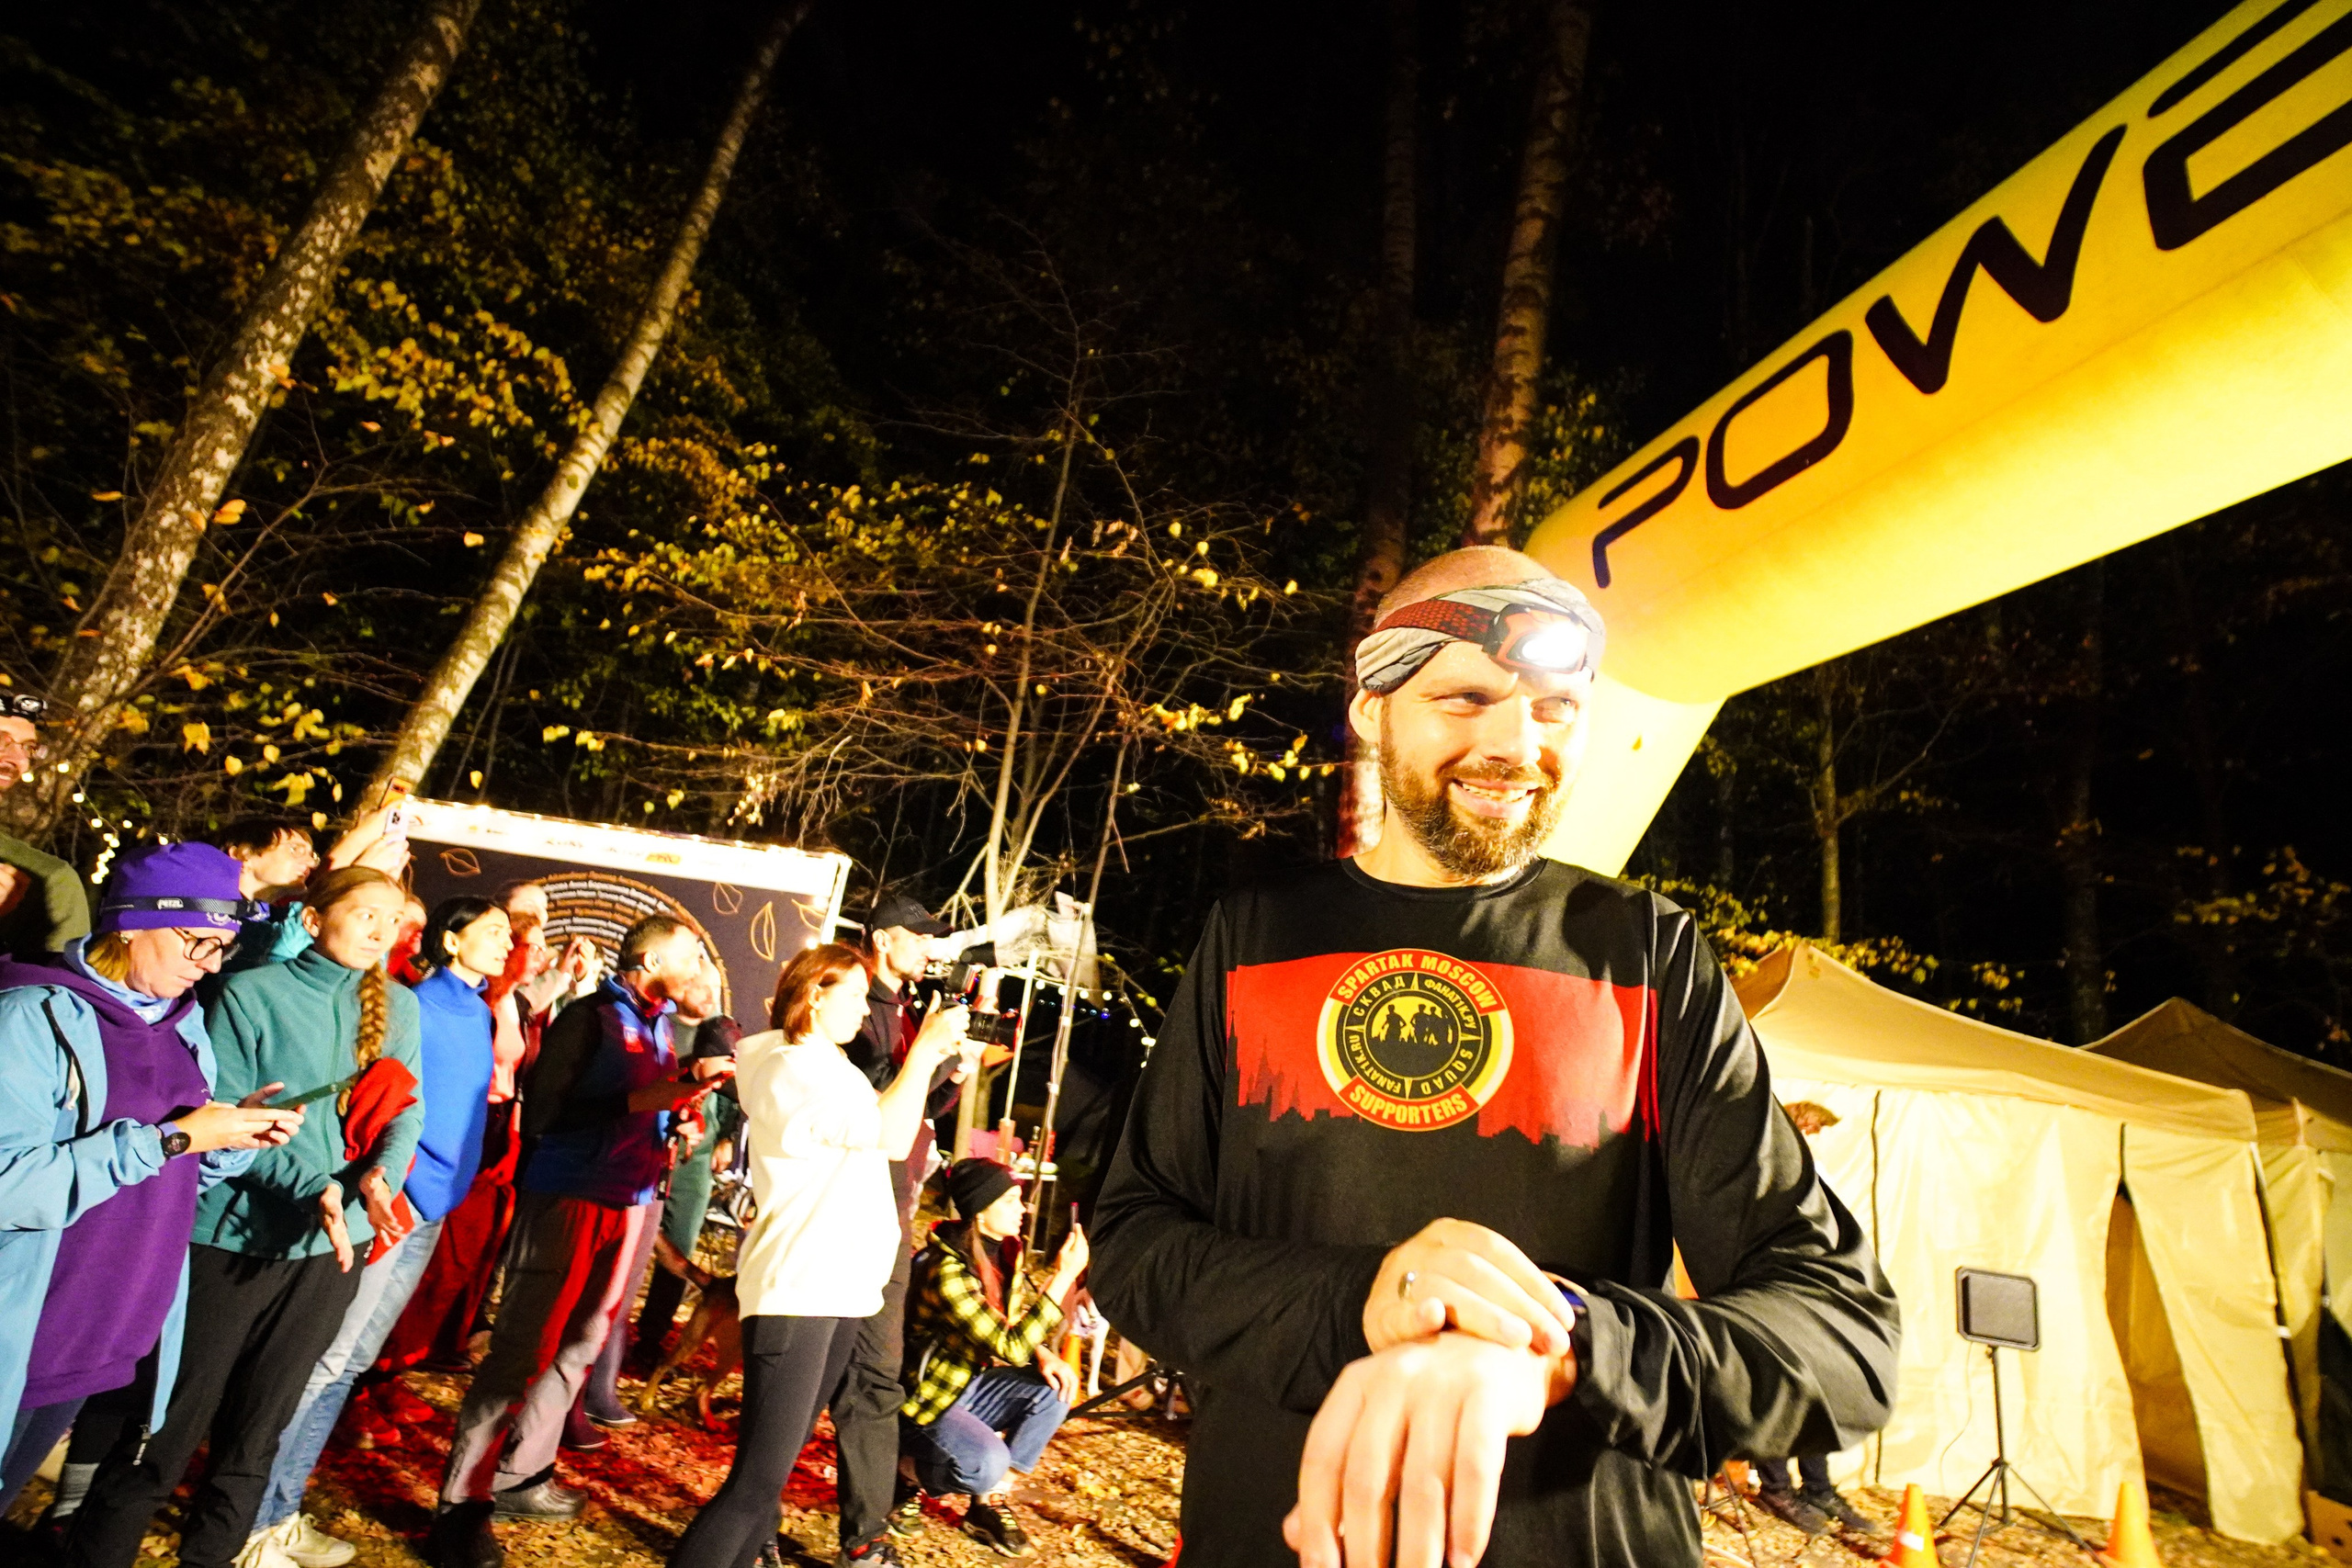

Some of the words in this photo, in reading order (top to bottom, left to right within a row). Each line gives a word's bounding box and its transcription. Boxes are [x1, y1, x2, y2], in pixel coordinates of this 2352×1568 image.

[1338, 953, 1414, 1000] SPARTAK
[1420, 955, 1497, 1009] MOSCOW
[1353, 976, 1406, 1017] СКВАД
[1420, 1051, 1473, 1095] SQUAD
[1350, 1085, 1468, 1124] SUPPORTERS
